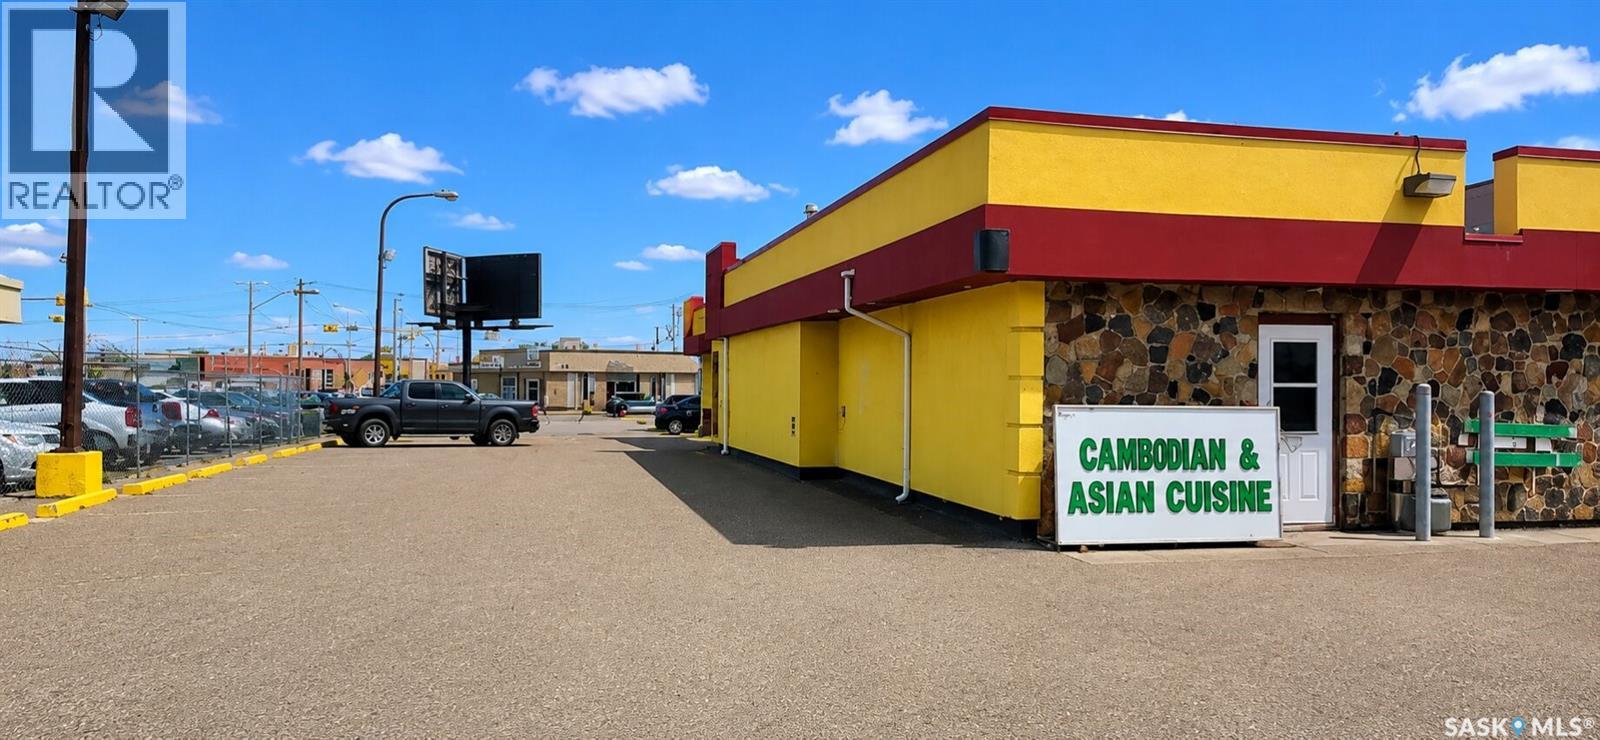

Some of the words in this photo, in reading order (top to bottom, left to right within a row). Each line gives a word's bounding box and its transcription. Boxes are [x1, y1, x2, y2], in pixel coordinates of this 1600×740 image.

[1079, 437, 1226, 471] CAMBODIAN
[1239, 438, 1260, 470] &
[1067, 481, 1155, 514] ASIAN
[1165, 480, 1273, 513] CUISINE
